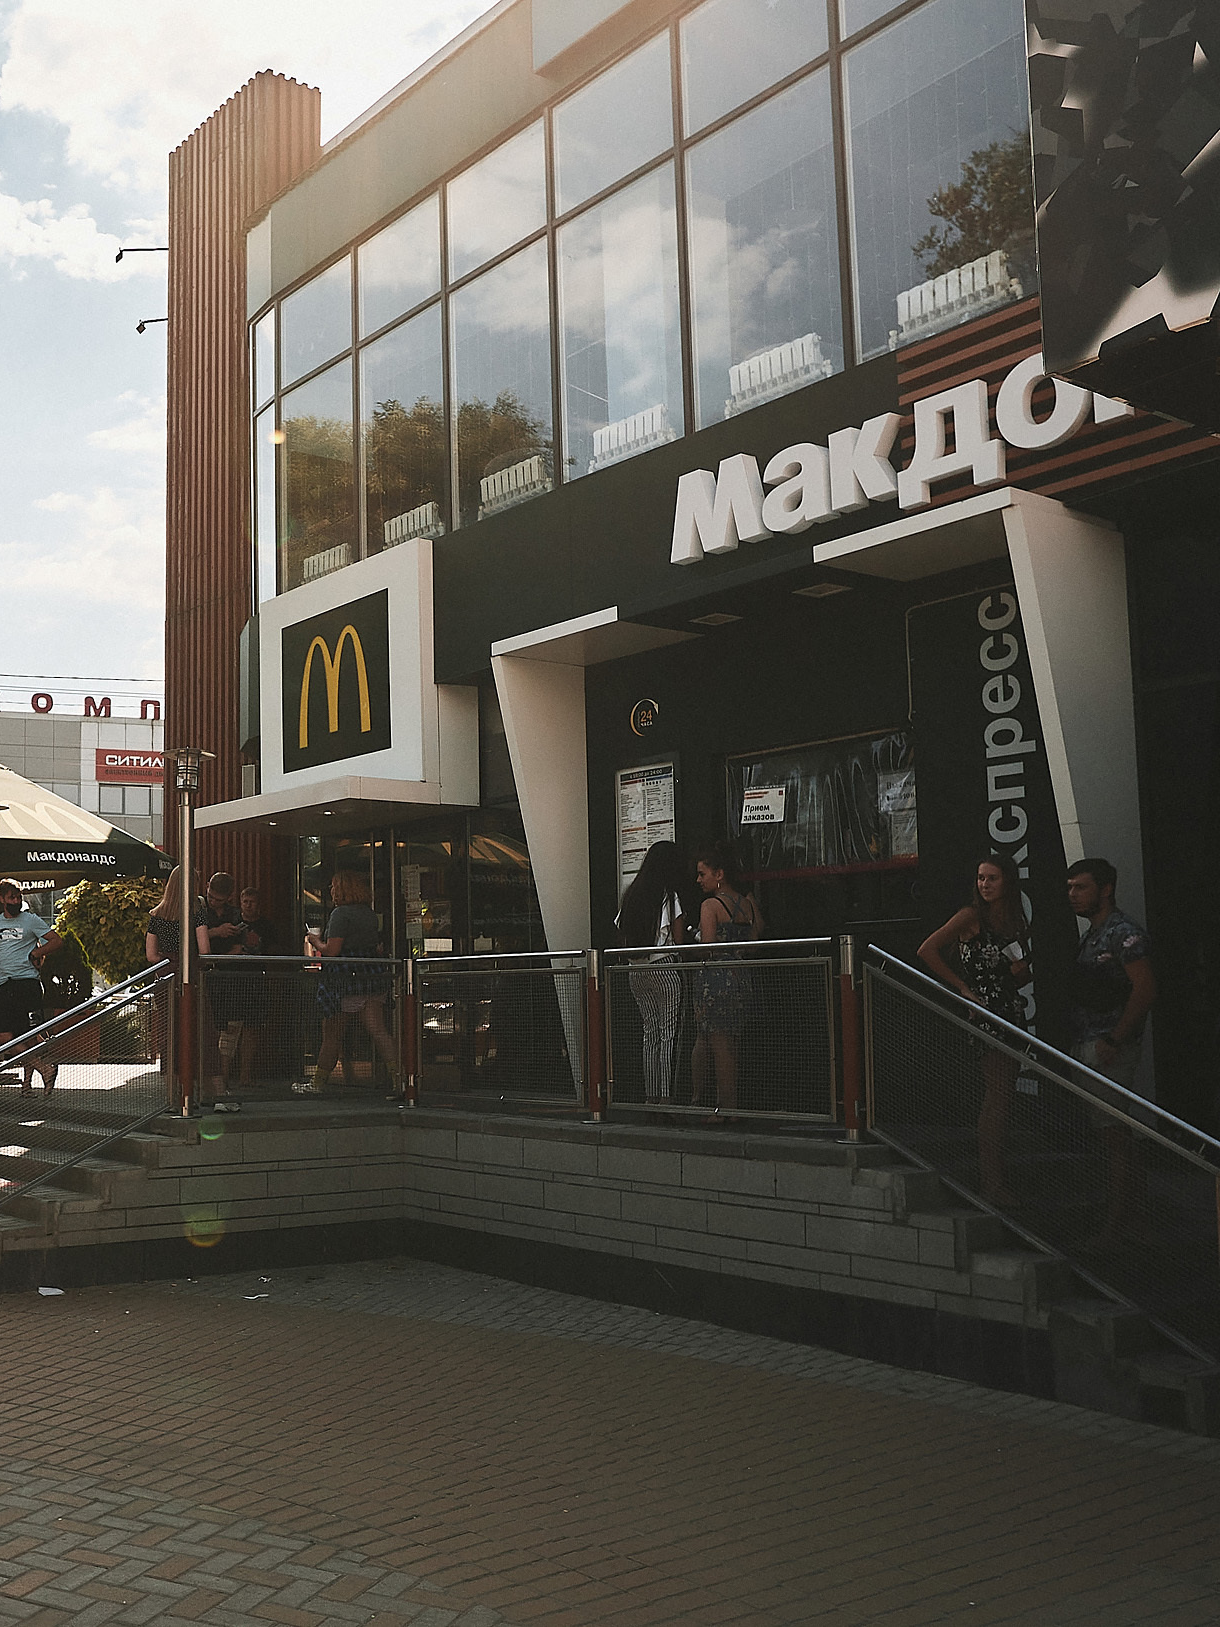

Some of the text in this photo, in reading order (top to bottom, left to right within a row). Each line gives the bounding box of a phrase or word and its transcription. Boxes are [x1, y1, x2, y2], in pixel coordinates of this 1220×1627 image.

[638, 708, 653, 721] 24
[105, 754, 164, 767] СИТИЛ
[26, 850, 117, 867] Макдоналдс
